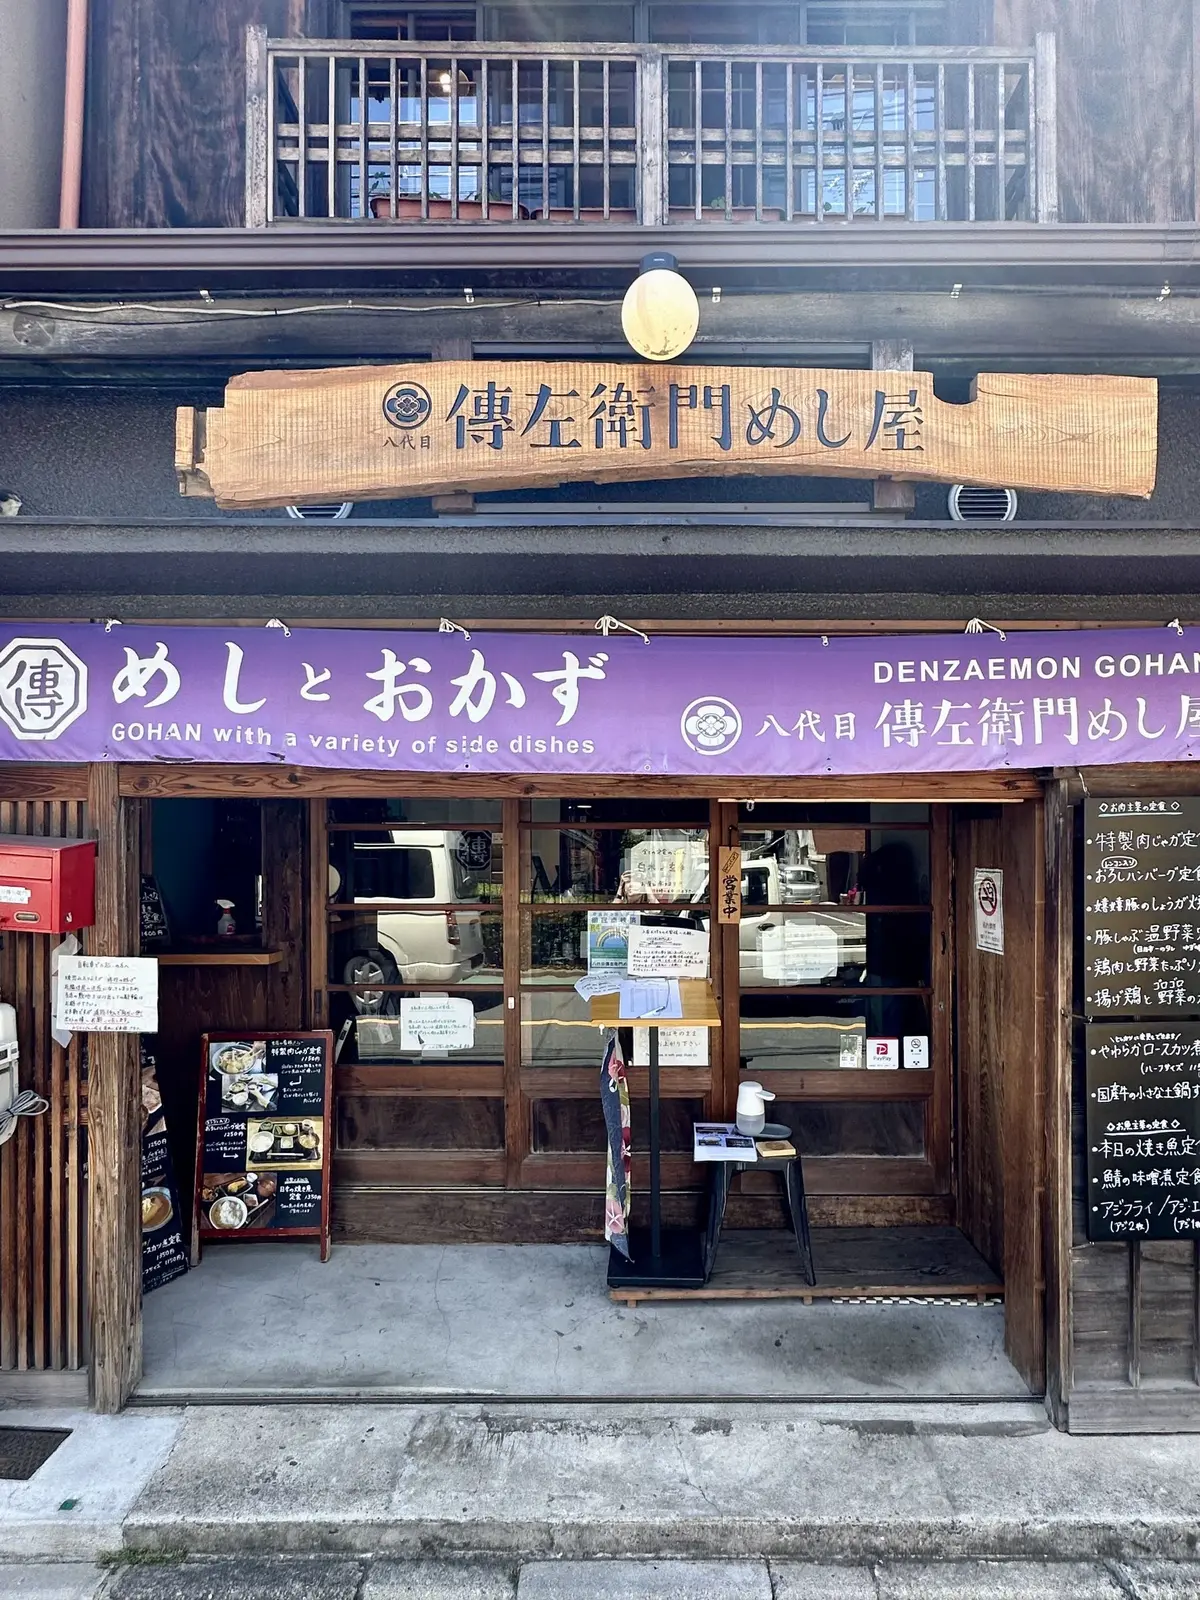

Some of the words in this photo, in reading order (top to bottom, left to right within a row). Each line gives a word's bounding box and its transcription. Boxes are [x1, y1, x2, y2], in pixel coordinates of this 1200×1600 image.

[444, 381, 924, 452] 傳左衛門めし屋
[382, 436, 431, 449] 八代目
[112, 641, 608, 726] めしとおかず
[874, 656, 1081, 684] DENZAEMON
[111, 721, 200, 742] GOHAN
[213, 726, 271, 746] with
[285, 733, 297, 747] a
[308, 733, 400, 758] variety
[411, 735, 436, 753] of
[445, 736, 499, 755] side
[508, 736, 595, 755] dishes
[755, 711, 856, 742] 八代目
[1095, 830, 1200, 852] 特製肉じゃが定
[722, 874, 738, 919] 営業中
[1094, 924, 1200, 945] 豚しゃぶ温野菜
[1094, 957, 1200, 977] 鶏肉と野菜たっぷり
[1098, 1135, 1200, 1159] 本日の焼き魚定
